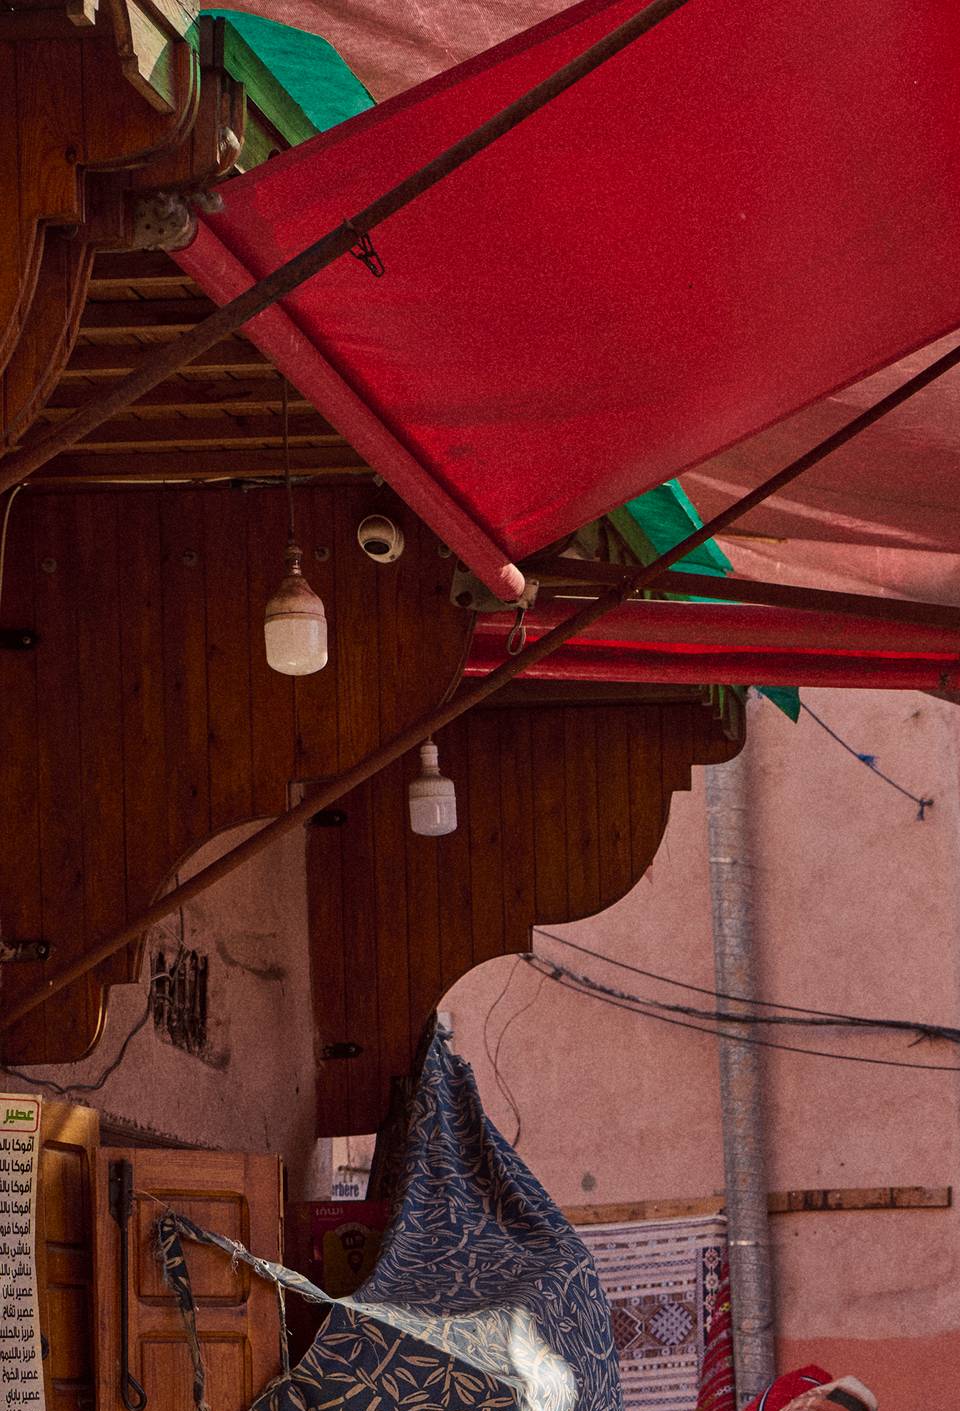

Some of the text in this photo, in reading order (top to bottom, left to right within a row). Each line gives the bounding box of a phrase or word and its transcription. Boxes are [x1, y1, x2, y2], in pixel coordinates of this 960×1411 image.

[3, 1109, 34, 1124] عصير
[15, 1288, 33, 1300] عصير
[16, 1307, 34, 1321] عصير
[20, 1370, 38, 1383] عصير
[22, 1391, 40, 1404] عصير
